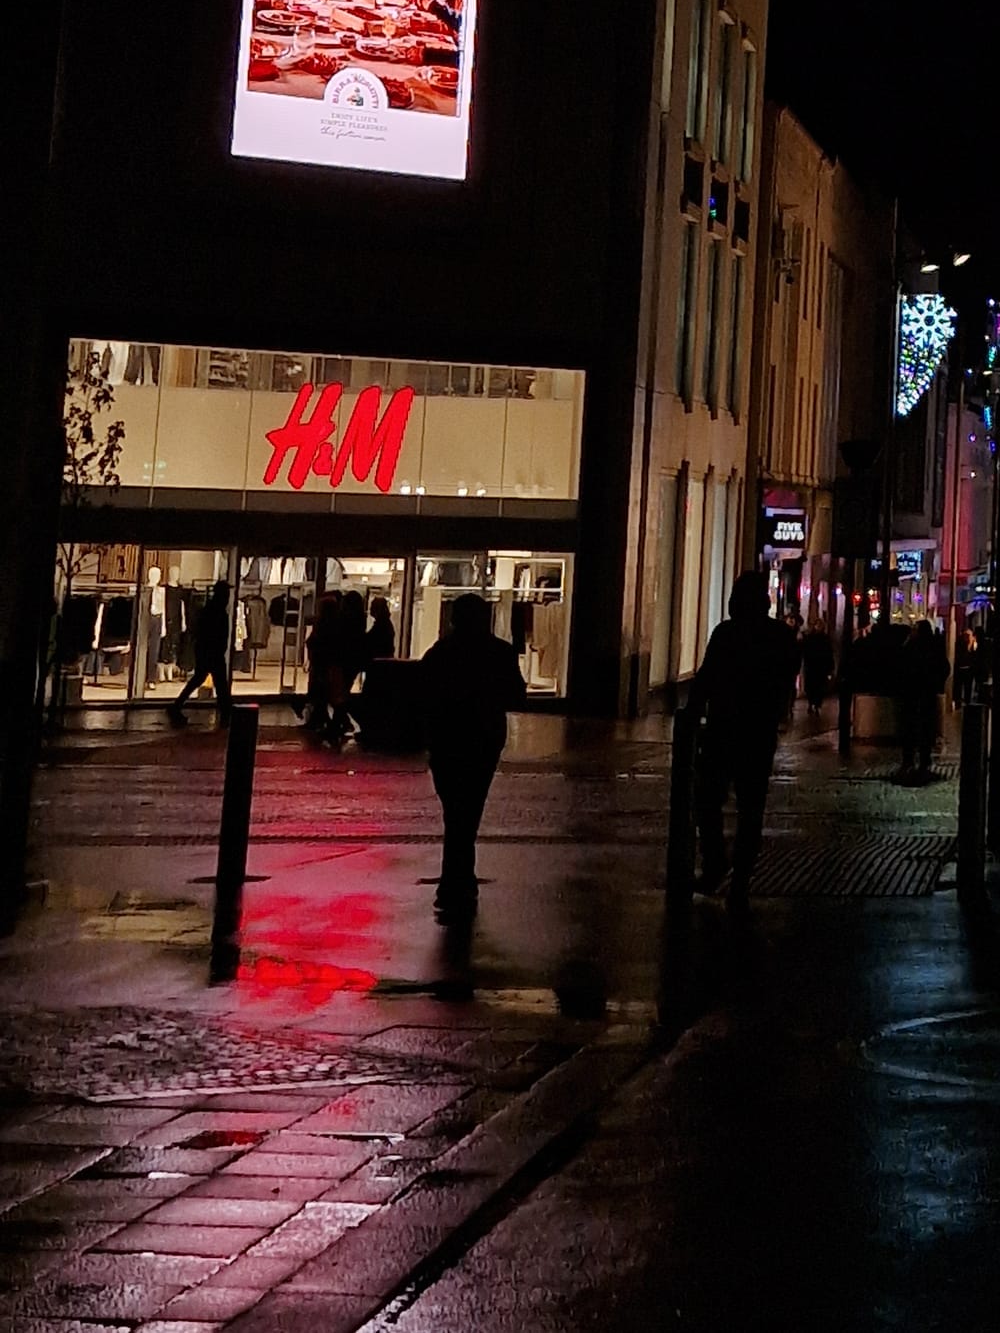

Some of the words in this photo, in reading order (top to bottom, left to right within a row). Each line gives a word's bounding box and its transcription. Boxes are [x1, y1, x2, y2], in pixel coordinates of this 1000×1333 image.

[264, 382, 415, 491] H&M
[777, 521, 803, 531] FIVE
[773, 530, 805, 541] GUYS
